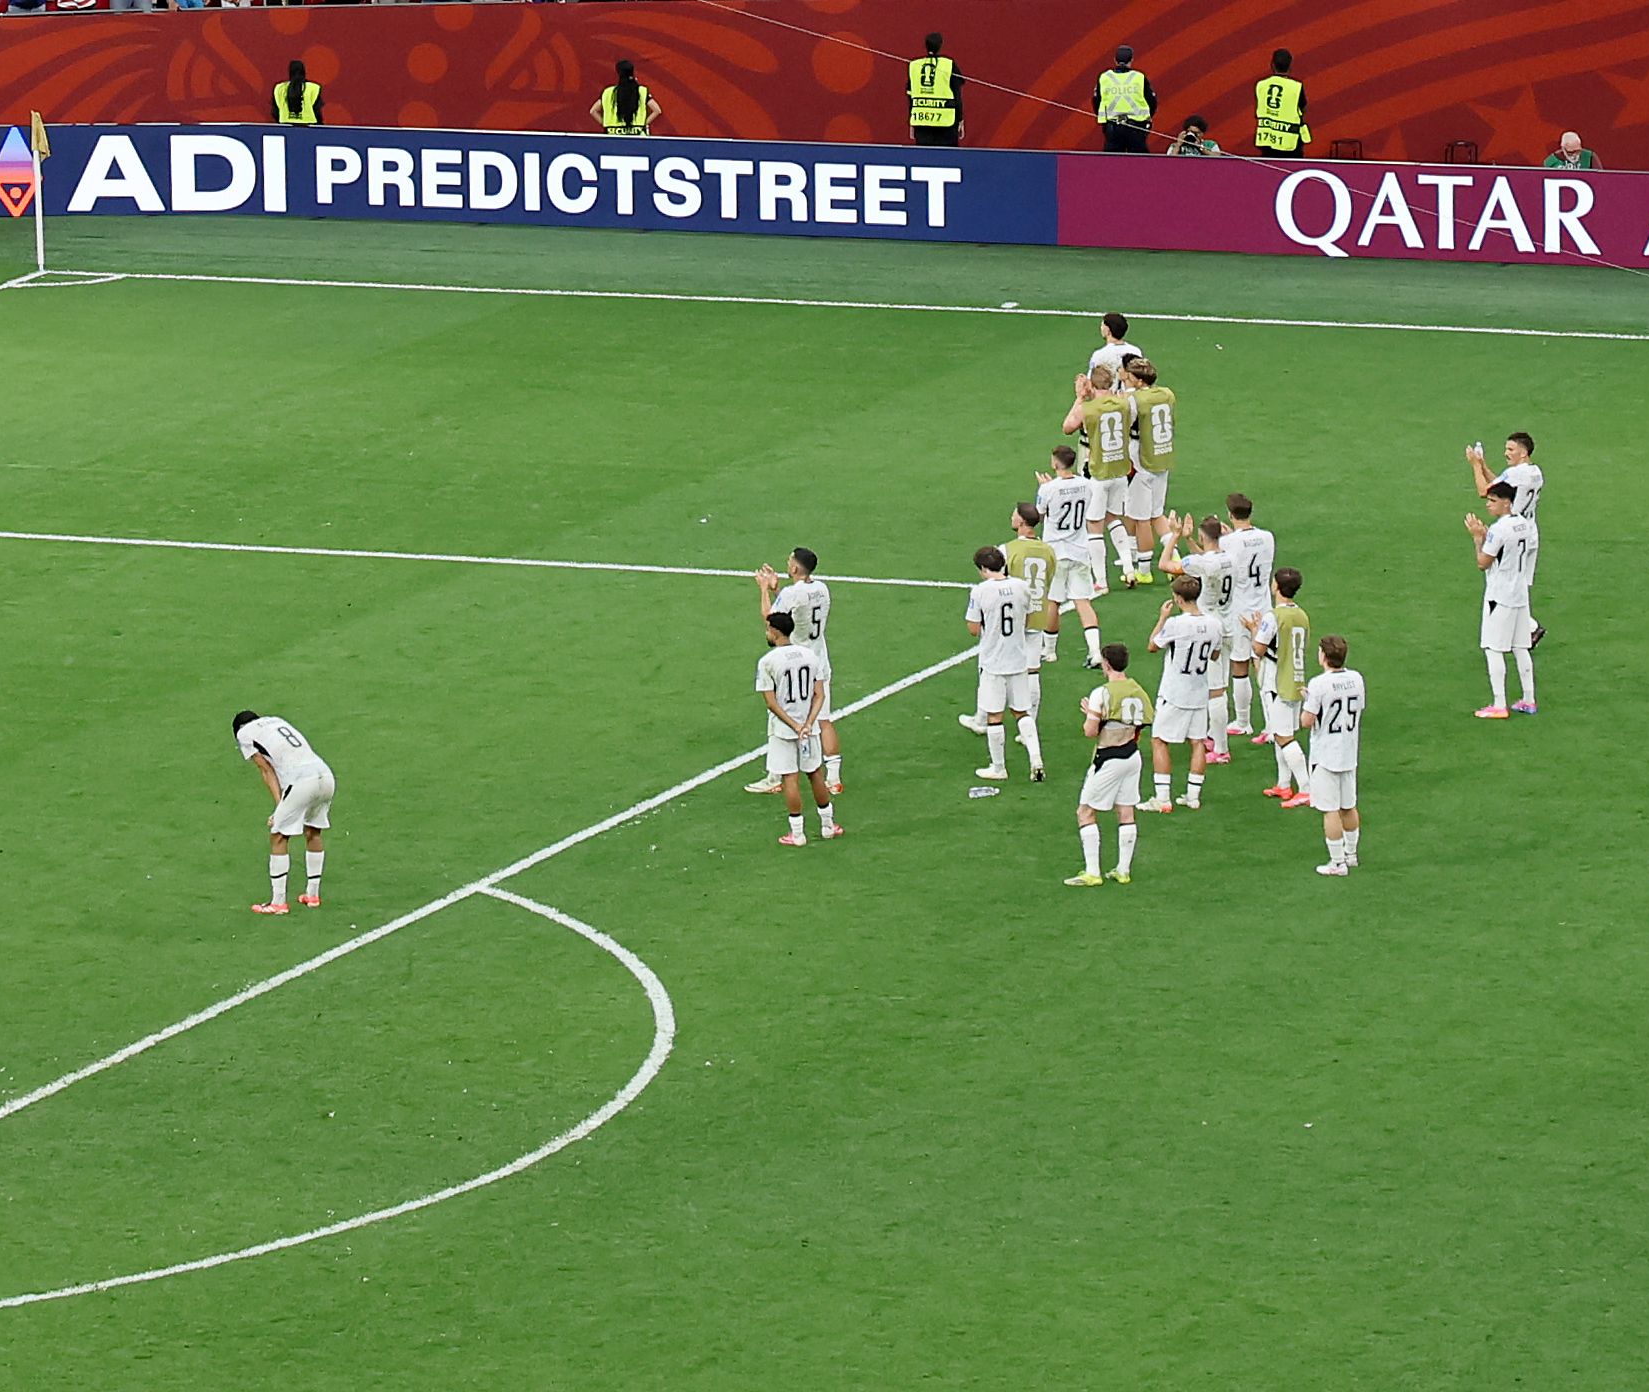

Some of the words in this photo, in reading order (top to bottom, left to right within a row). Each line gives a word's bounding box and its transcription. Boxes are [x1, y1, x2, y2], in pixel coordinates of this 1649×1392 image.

[911, 97, 947, 109] ECURITY
[1104, 85, 1140, 96] POLICE
[1258, 120, 1292, 132] ECURITY
[66, 134, 288, 213] ADI
[315, 145, 962, 228] PREDICTSTREET
[1274, 169, 1601, 257] QATAR
[1056, 498, 1088, 533] 20
[1247, 552, 1263, 588] 4
[1516, 538, 1528, 574] 7
[1217, 573, 1234, 607] 9
[808, 605, 822, 642] 5
[1000, 602, 1015, 639] 6
[1180, 639, 1213, 676] 19
[784, 664, 811, 705] 10
[1327, 694, 1360, 736] 25
